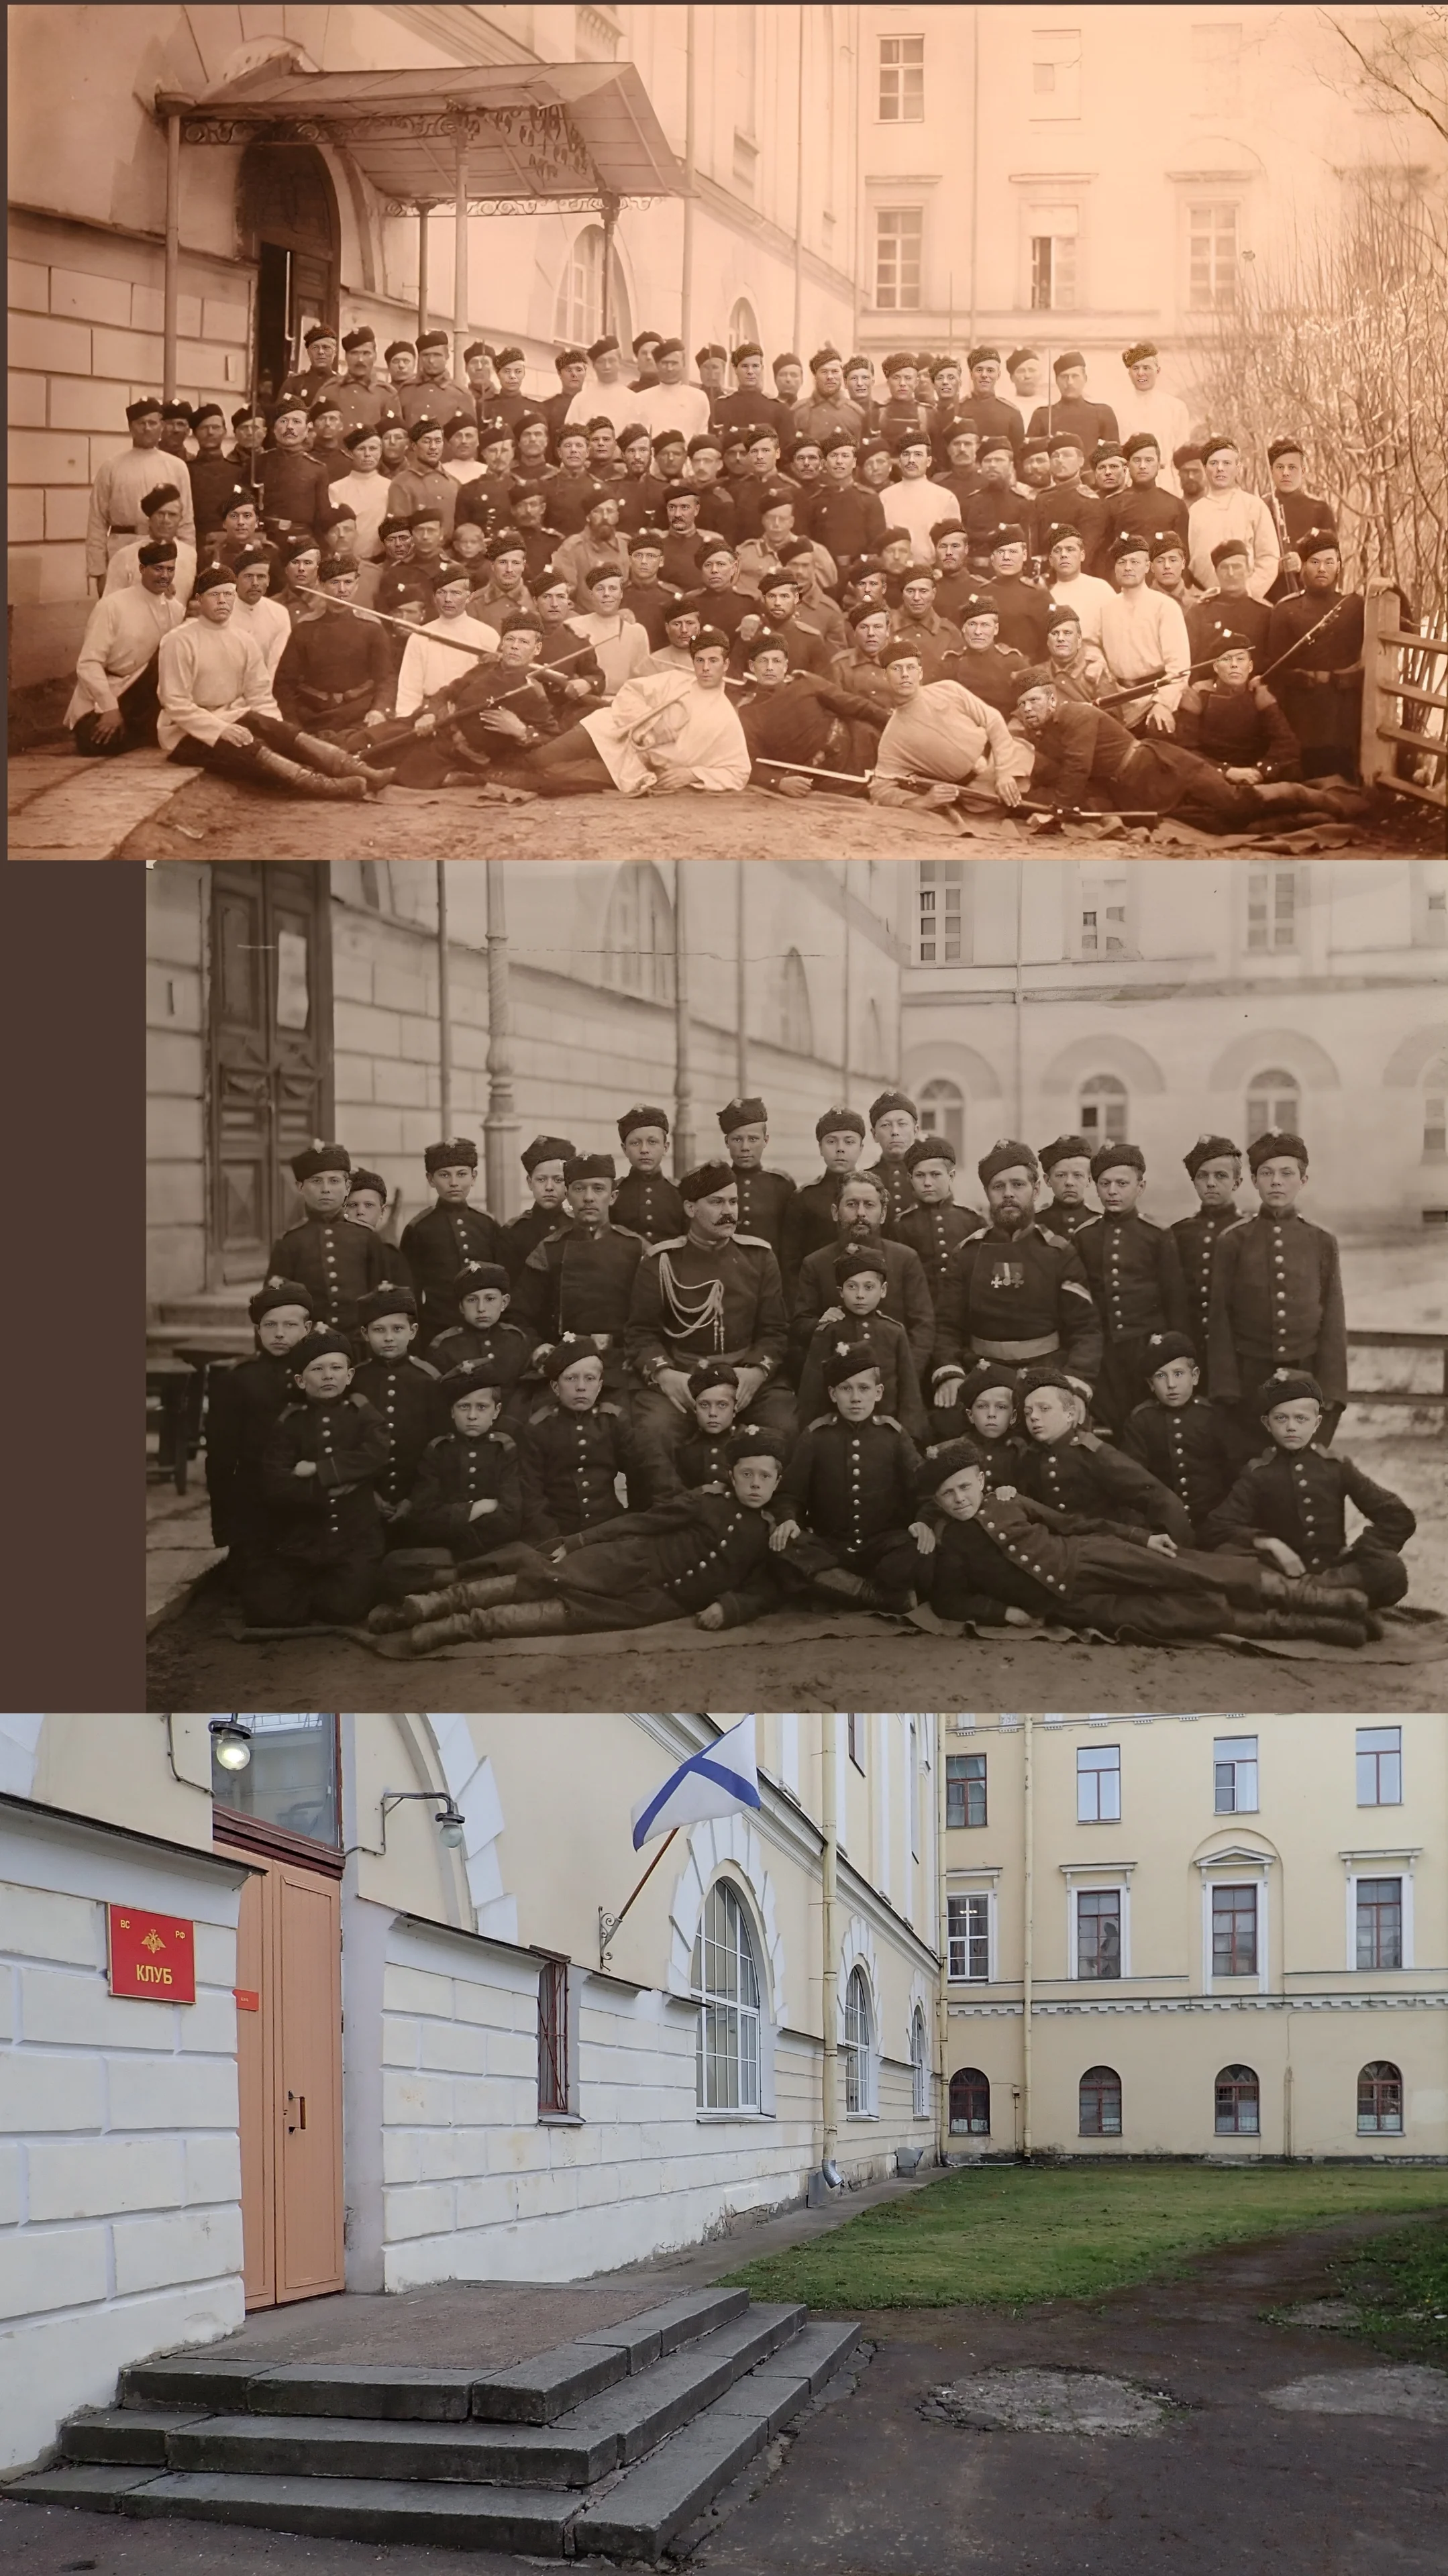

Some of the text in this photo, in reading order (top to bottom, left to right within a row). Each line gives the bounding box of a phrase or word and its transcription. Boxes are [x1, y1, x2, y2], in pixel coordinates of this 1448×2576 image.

[120, 1919, 186, 1939] ВС РФ
[136, 1964, 173, 1984] КЛУБ
